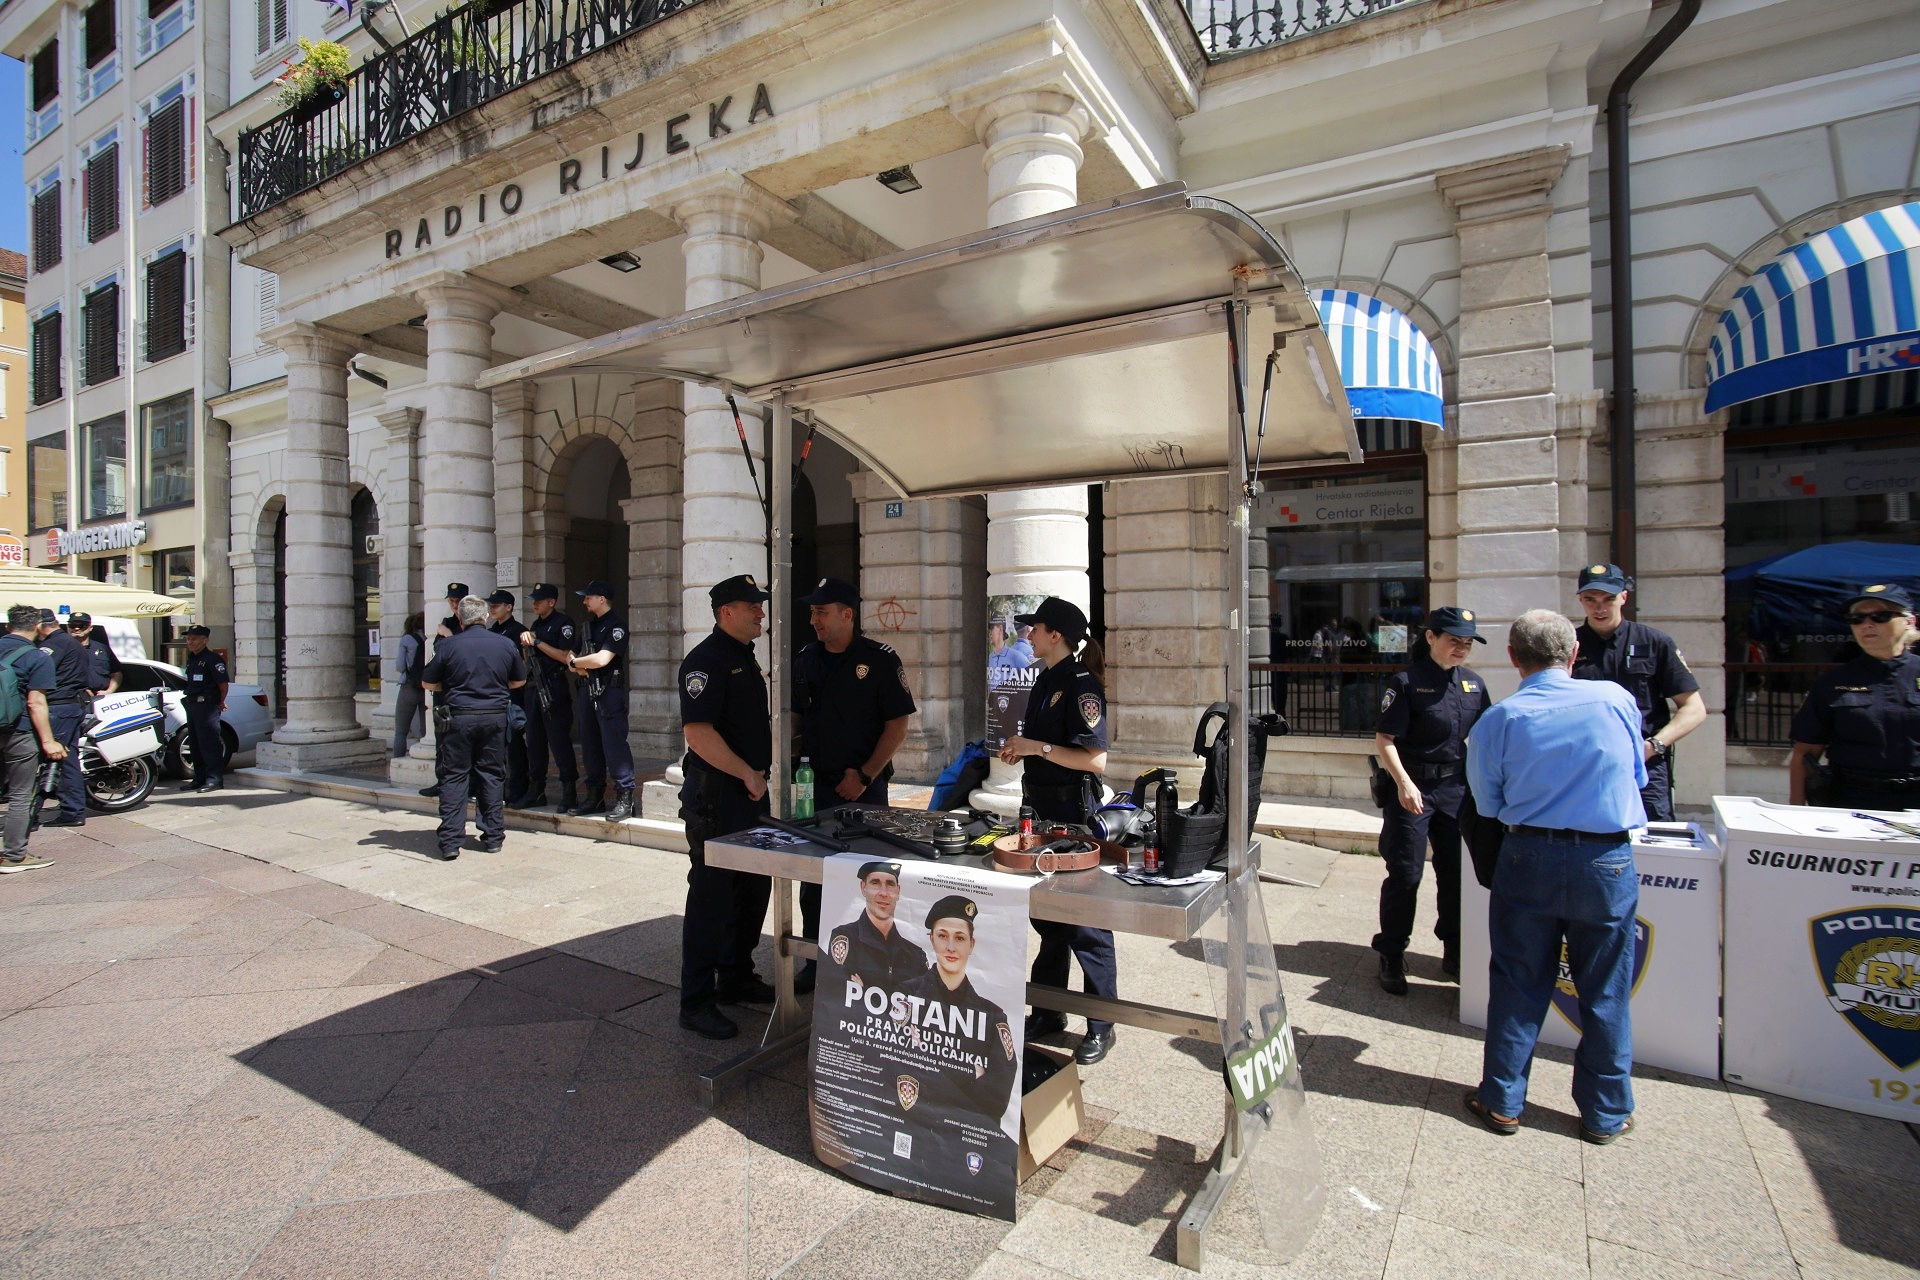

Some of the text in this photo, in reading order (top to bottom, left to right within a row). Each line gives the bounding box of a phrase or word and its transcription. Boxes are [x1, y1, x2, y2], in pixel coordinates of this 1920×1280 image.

[385, 83, 773, 259] RADIO RIJEKA
[1316, 487, 1414, 501] Hrvatska radiotelevizija
[888, 504, 899, 513] 24
[1316, 502, 1414, 521] Centar Rijeka
[61, 520, 143, 556] BURGER KING
[366, 536, 376, 552] 6
[136, 602, 174, 613] Coca-Cola
[1285, 639, 1333, 647] PROGRAM
[101, 693, 154, 713] POLICIJA
[1747, 849, 1884, 878] SIGURNOST
[1890, 862, 1900, 878] I
[844, 980, 987, 1042] POSTANI
[866, 1015, 962, 1050] PRAVOSUDNI
[839, 1020, 989, 1068] POLICAJAC/POLICAJKA!
[851, 1036, 865, 1045] Upiši
[872, 1043, 893, 1052] razred
